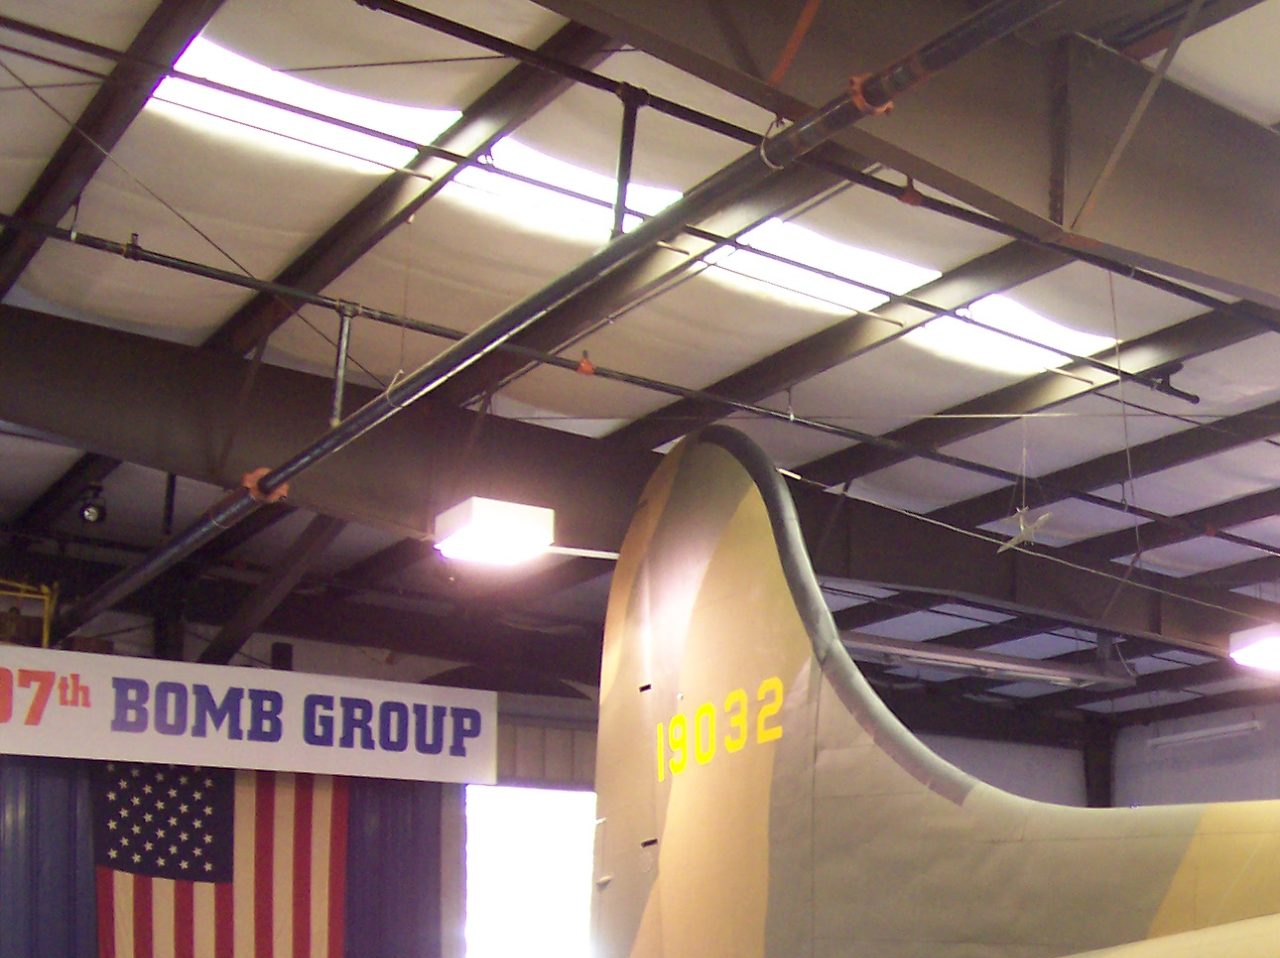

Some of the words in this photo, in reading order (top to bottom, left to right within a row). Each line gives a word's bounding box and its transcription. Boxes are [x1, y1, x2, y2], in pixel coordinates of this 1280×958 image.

[111, 677, 283, 743] BOMB
[303, 694, 481, 757] GROUP
[656, 675, 784, 783] 19032
